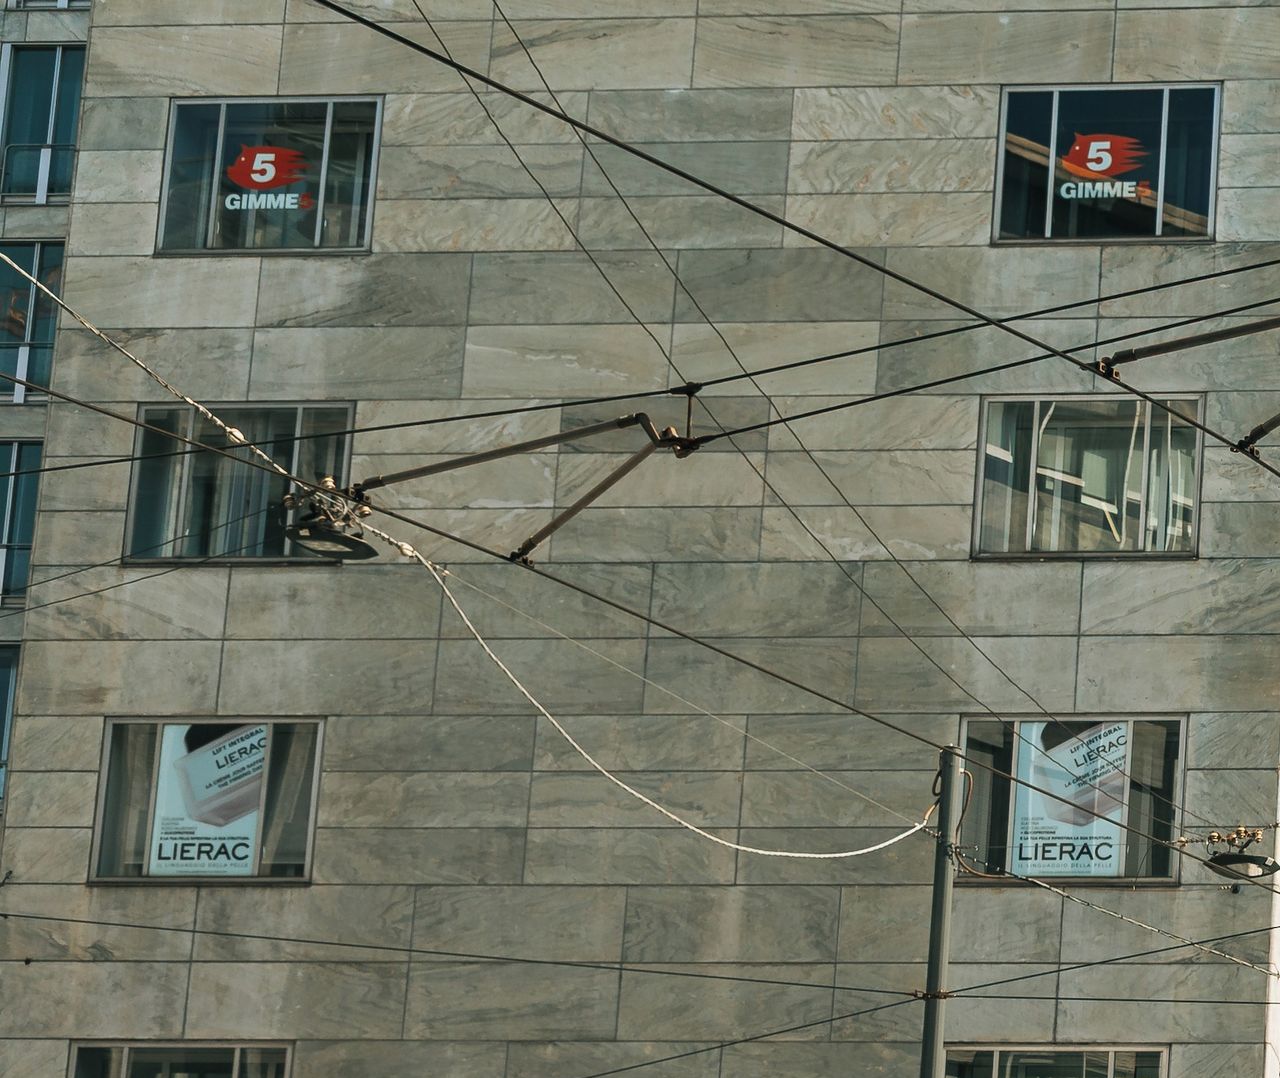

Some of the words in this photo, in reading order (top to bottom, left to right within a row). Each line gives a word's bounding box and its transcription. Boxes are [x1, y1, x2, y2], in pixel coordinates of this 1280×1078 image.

[250, 153, 277, 183] 5
[1086, 141, 1113, 172] 5
[212, 744, 228, 756] LIFT
[228, 728, 264, 748] INTEGRAL
[215, 737, 267, 769] LIERAC
[1070, 743, 1086, 754] LIFT
[1074, 735, 1128, 768] LIERAC
[157, 842, 250, 861] LIERAC
[1018, 842, 1113, 861] LIERAC
